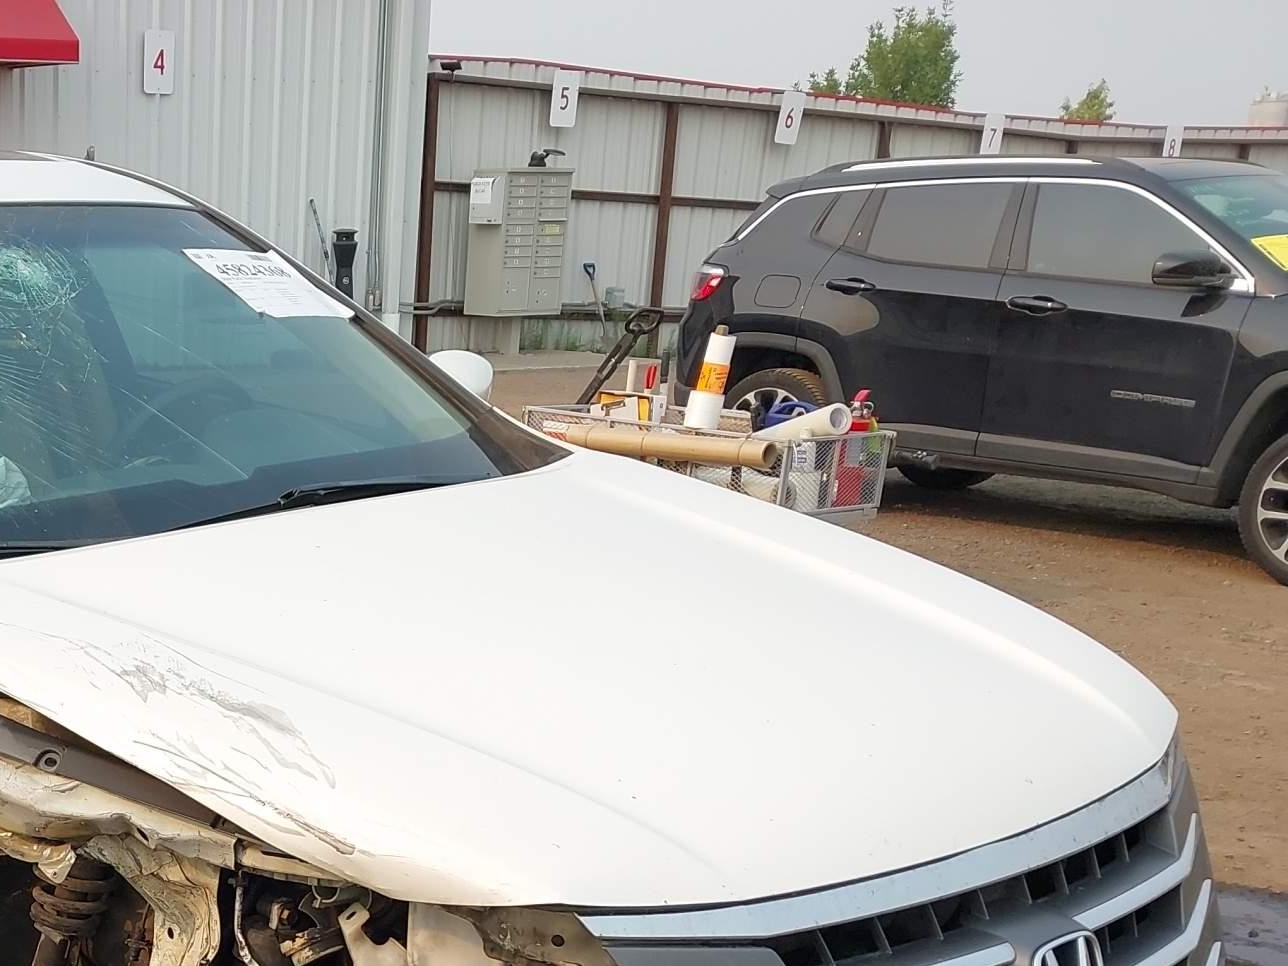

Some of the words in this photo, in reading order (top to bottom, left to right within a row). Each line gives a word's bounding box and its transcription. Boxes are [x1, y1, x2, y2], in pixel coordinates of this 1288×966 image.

[152, 49, 166, 75] 4
[560, 86, 571, 111] 5
[784, 107, 795, 129] 6
[988, 128, 998, 149] 7
[1167, 138, 1177, 157] 8
